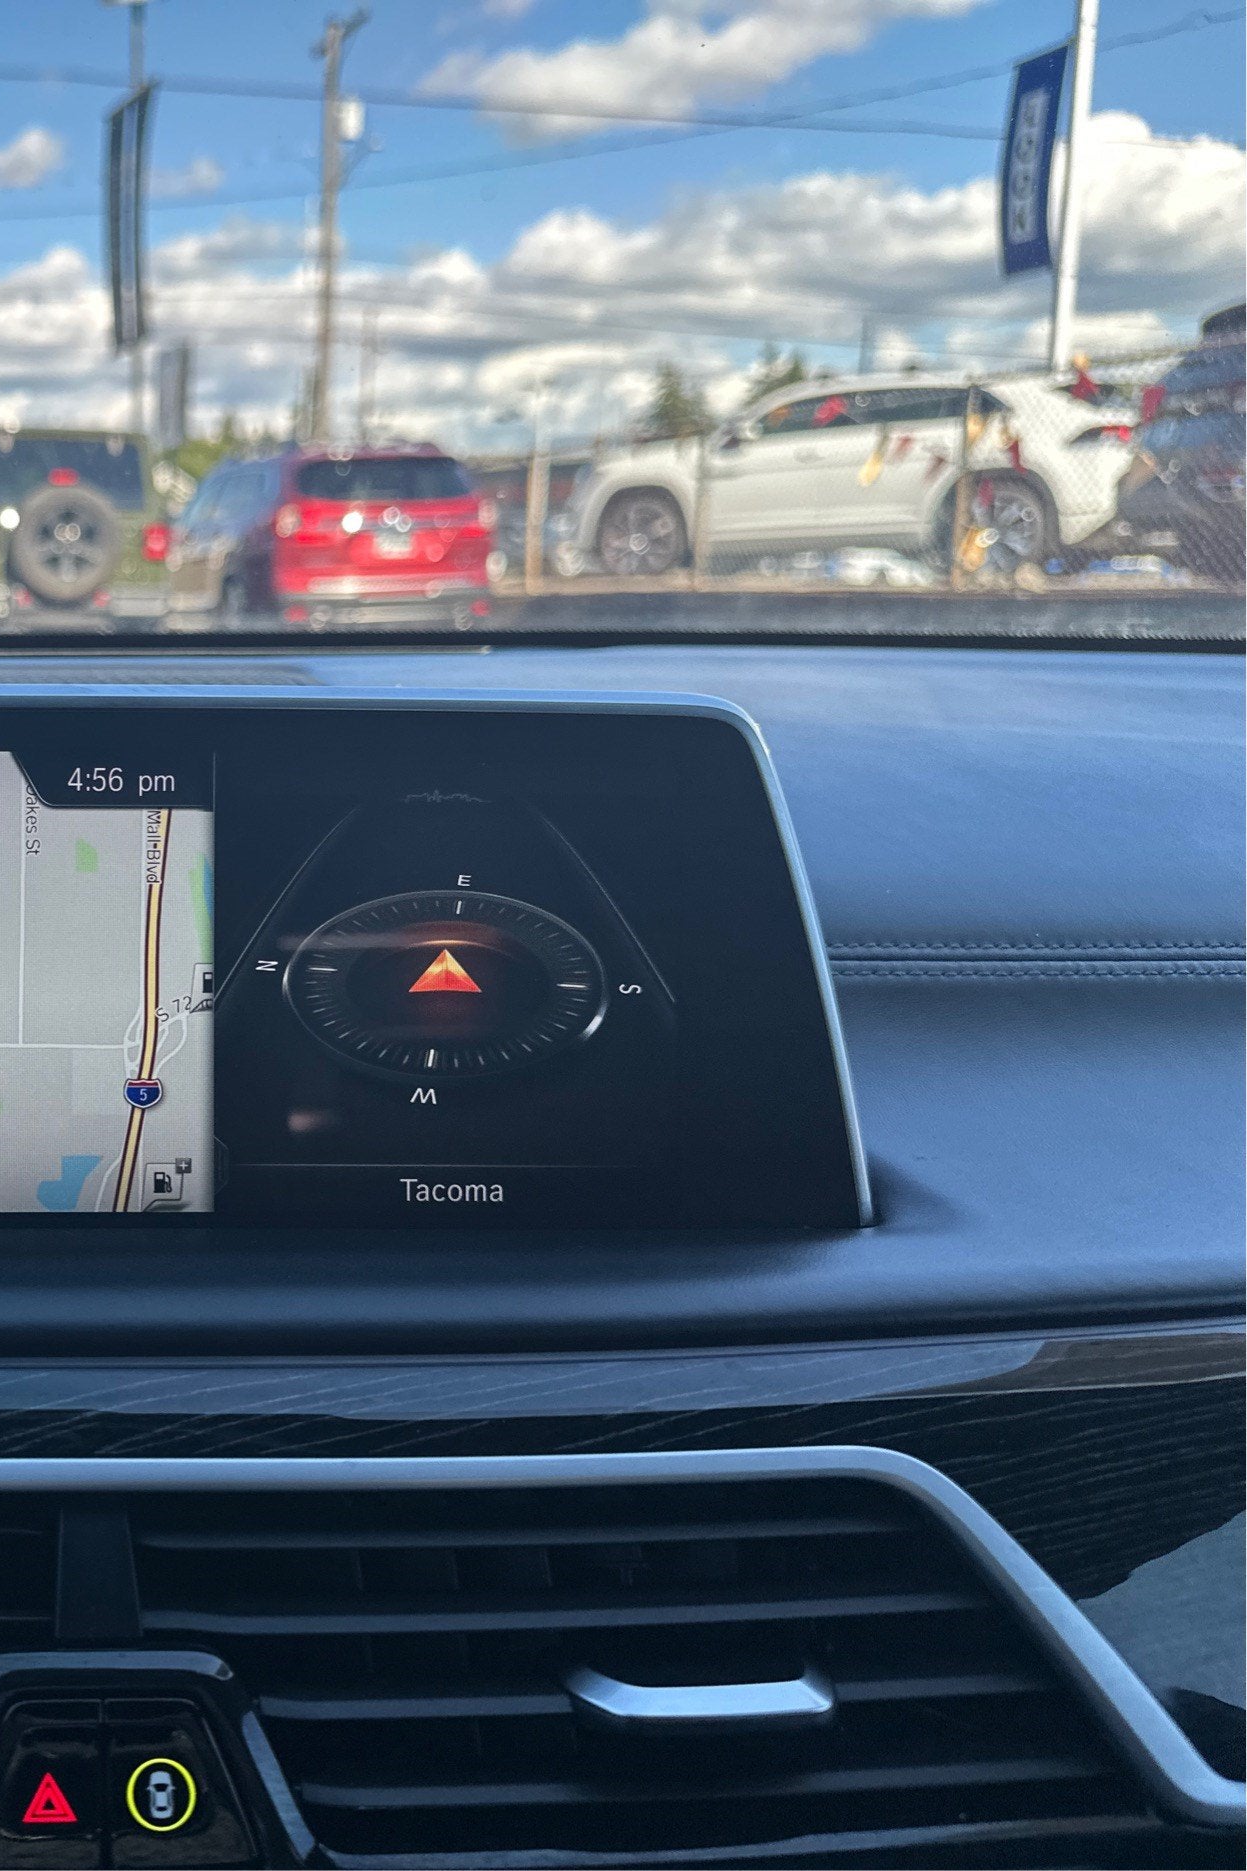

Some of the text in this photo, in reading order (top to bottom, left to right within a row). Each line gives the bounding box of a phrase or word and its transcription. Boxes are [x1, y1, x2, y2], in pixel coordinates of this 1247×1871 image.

[67, 767, 175, 797] 4:56 pm
[26, 839, 41, 856] St
[457, 874, 472, 887] E
[255, 959, 279, 972] N
[619, 983, 642, 995] S
[155, 1007, 169, 1022] S
[139, 1088, 148, 1101] 5
[399, 1178, 504, 1202] Tacoma
